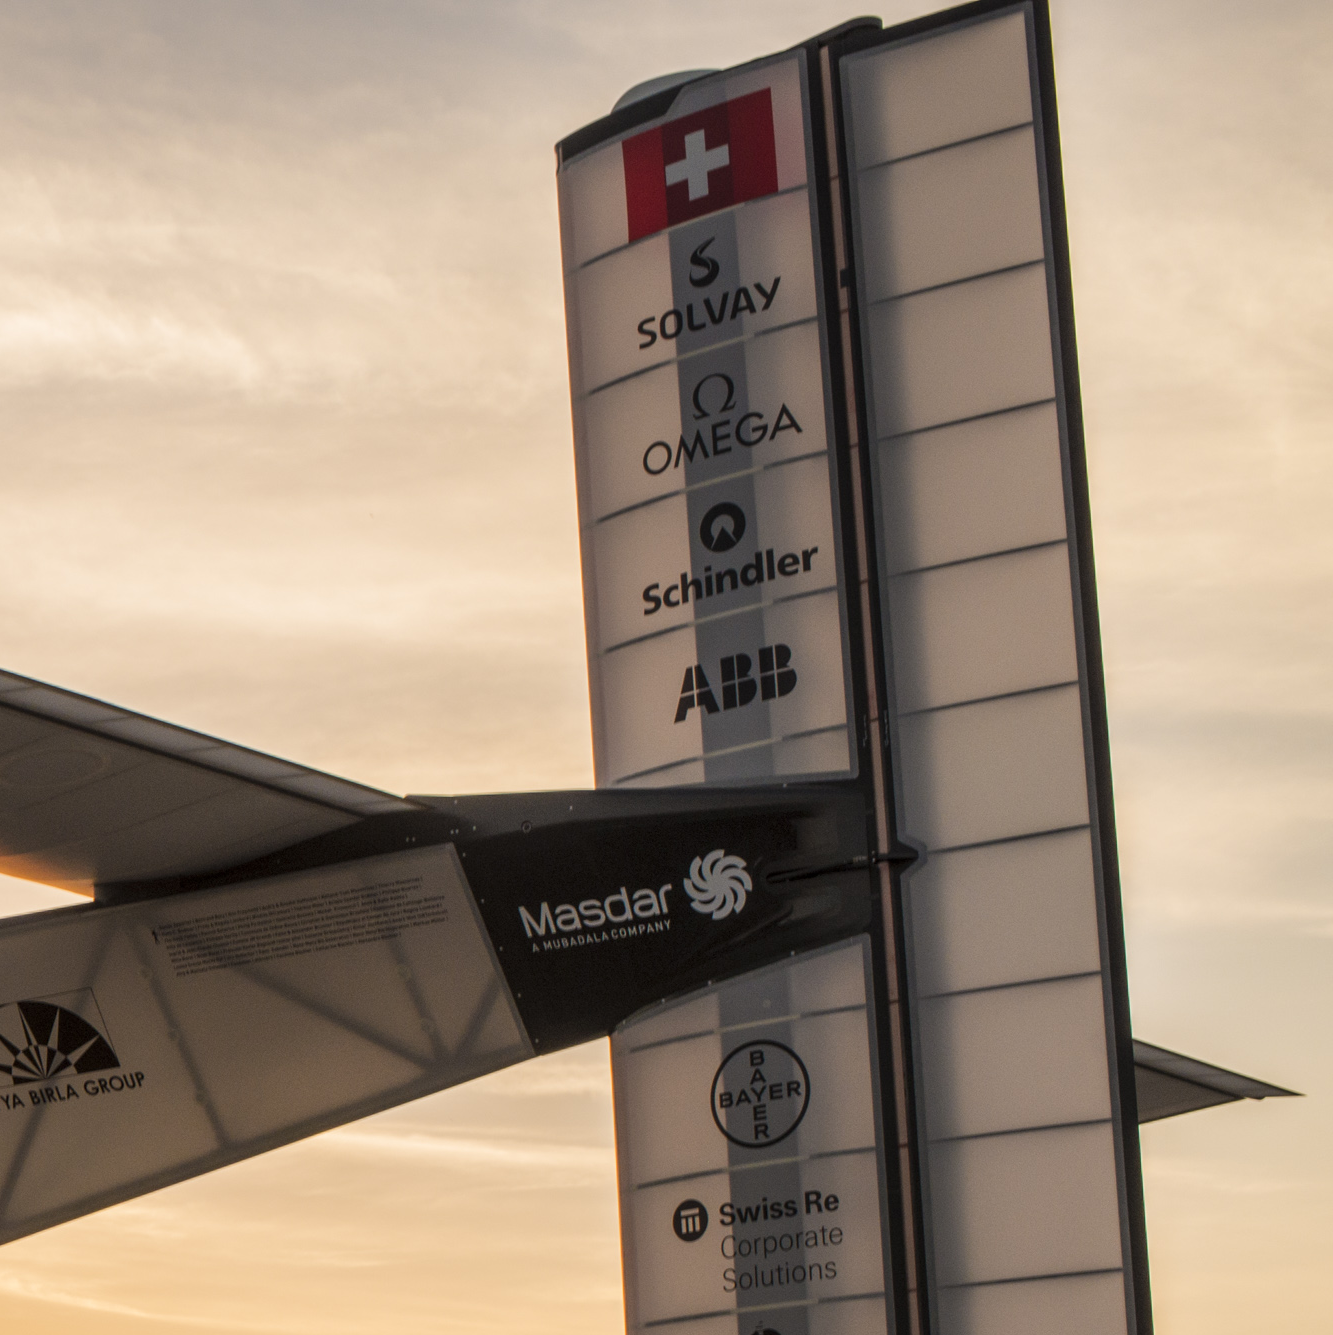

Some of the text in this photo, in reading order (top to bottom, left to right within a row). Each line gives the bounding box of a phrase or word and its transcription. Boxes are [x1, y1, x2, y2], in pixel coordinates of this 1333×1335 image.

[636, 276, 782, 350] SOLVAY
[642, 403, 803, 476] OMEGA
[642, 546, 819, 616] Schindler
[674, 643, 798, 724] ABB
[518, 883, 673, 939] Masdar
[532, 919, 672, 953] A MUBADALA COMPANY
[28, 1083, 79, 1106] BIRLA
[83, 1071, 145, 1097] GROUP
[719, 1080, 802, 1109] BAYER
[749, 1050, 770, 1140] BAYER
[719, 1190, 840, 1227] Swiss Re
[721, 1225, 844, 1260] Corporate
[723, 1261, 837, 1293] Solutions
